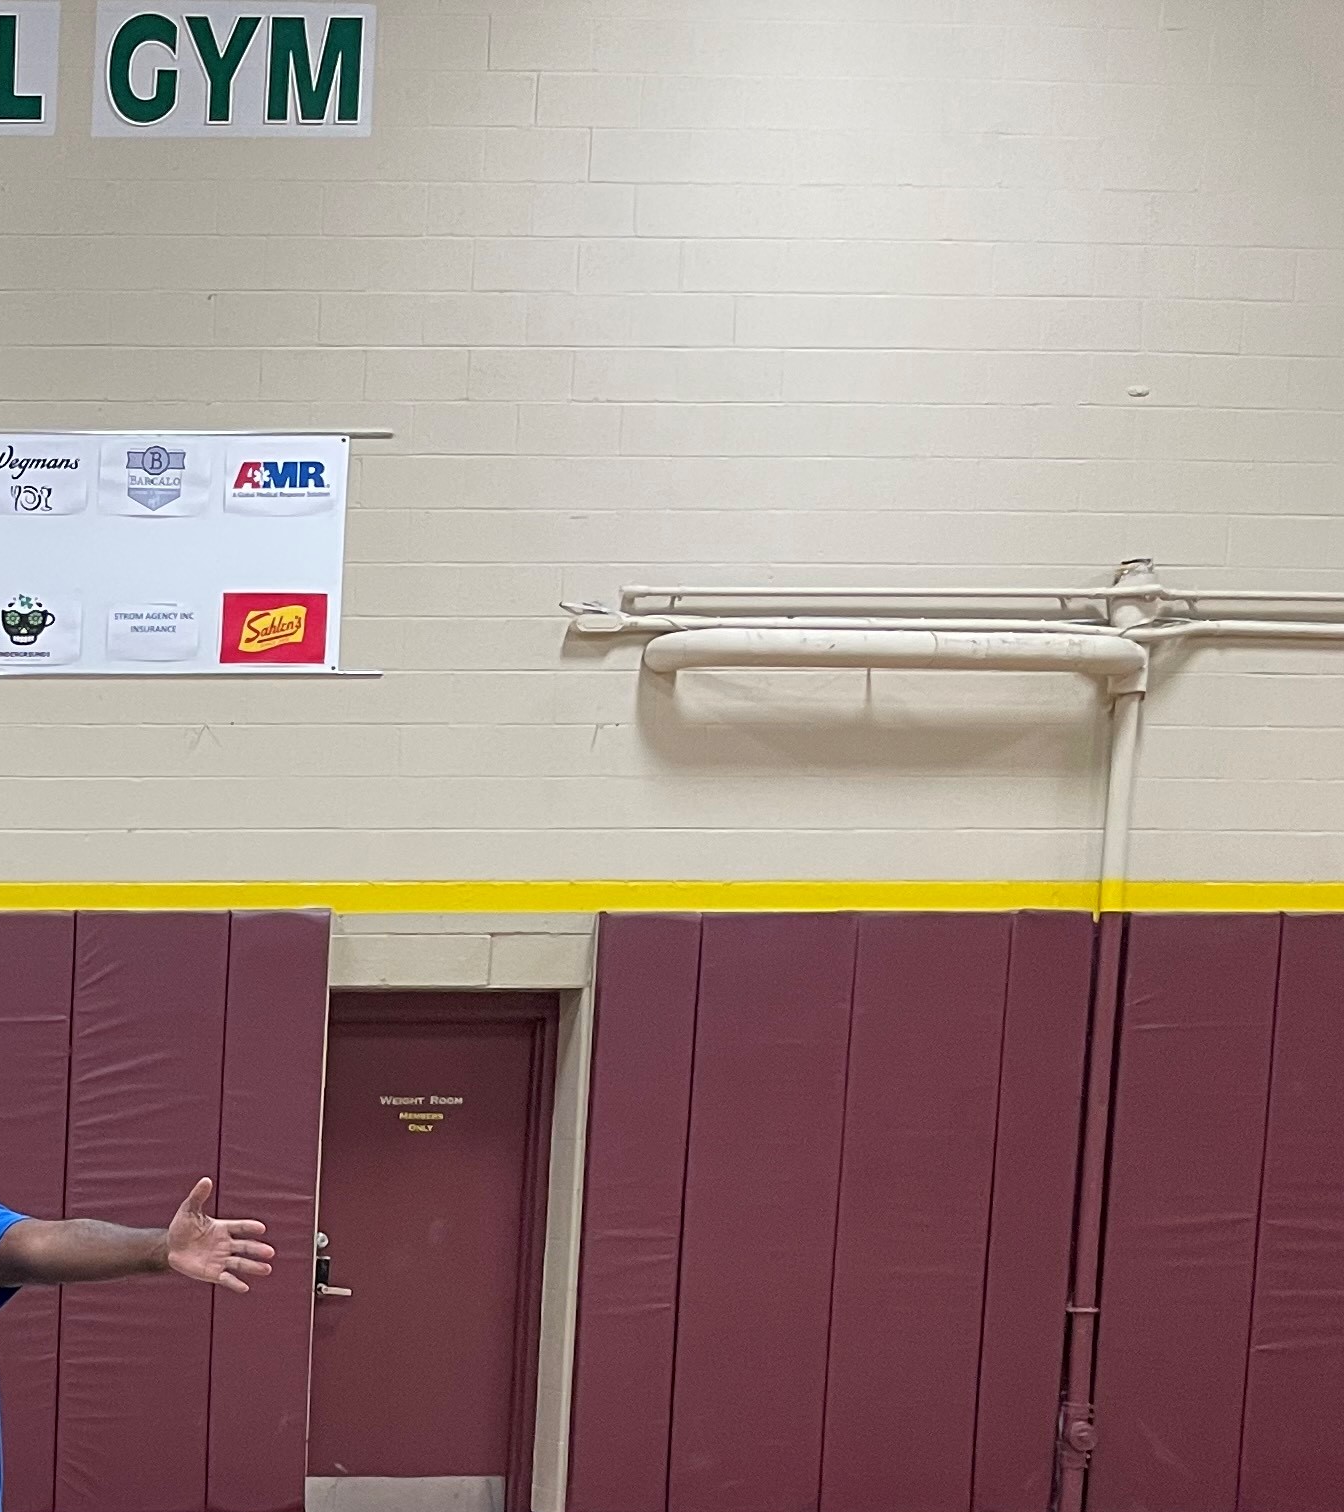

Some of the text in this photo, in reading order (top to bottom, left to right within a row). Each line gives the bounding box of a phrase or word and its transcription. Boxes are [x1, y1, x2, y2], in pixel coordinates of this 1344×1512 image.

[107, 11, 365, 126] GYM
[149, 452, 162, 469] B
[129, 475, 181, 486] BARCALO
[233, 461, 325, 489] AMR
[244, 612, 302, 643] Sahlen's
